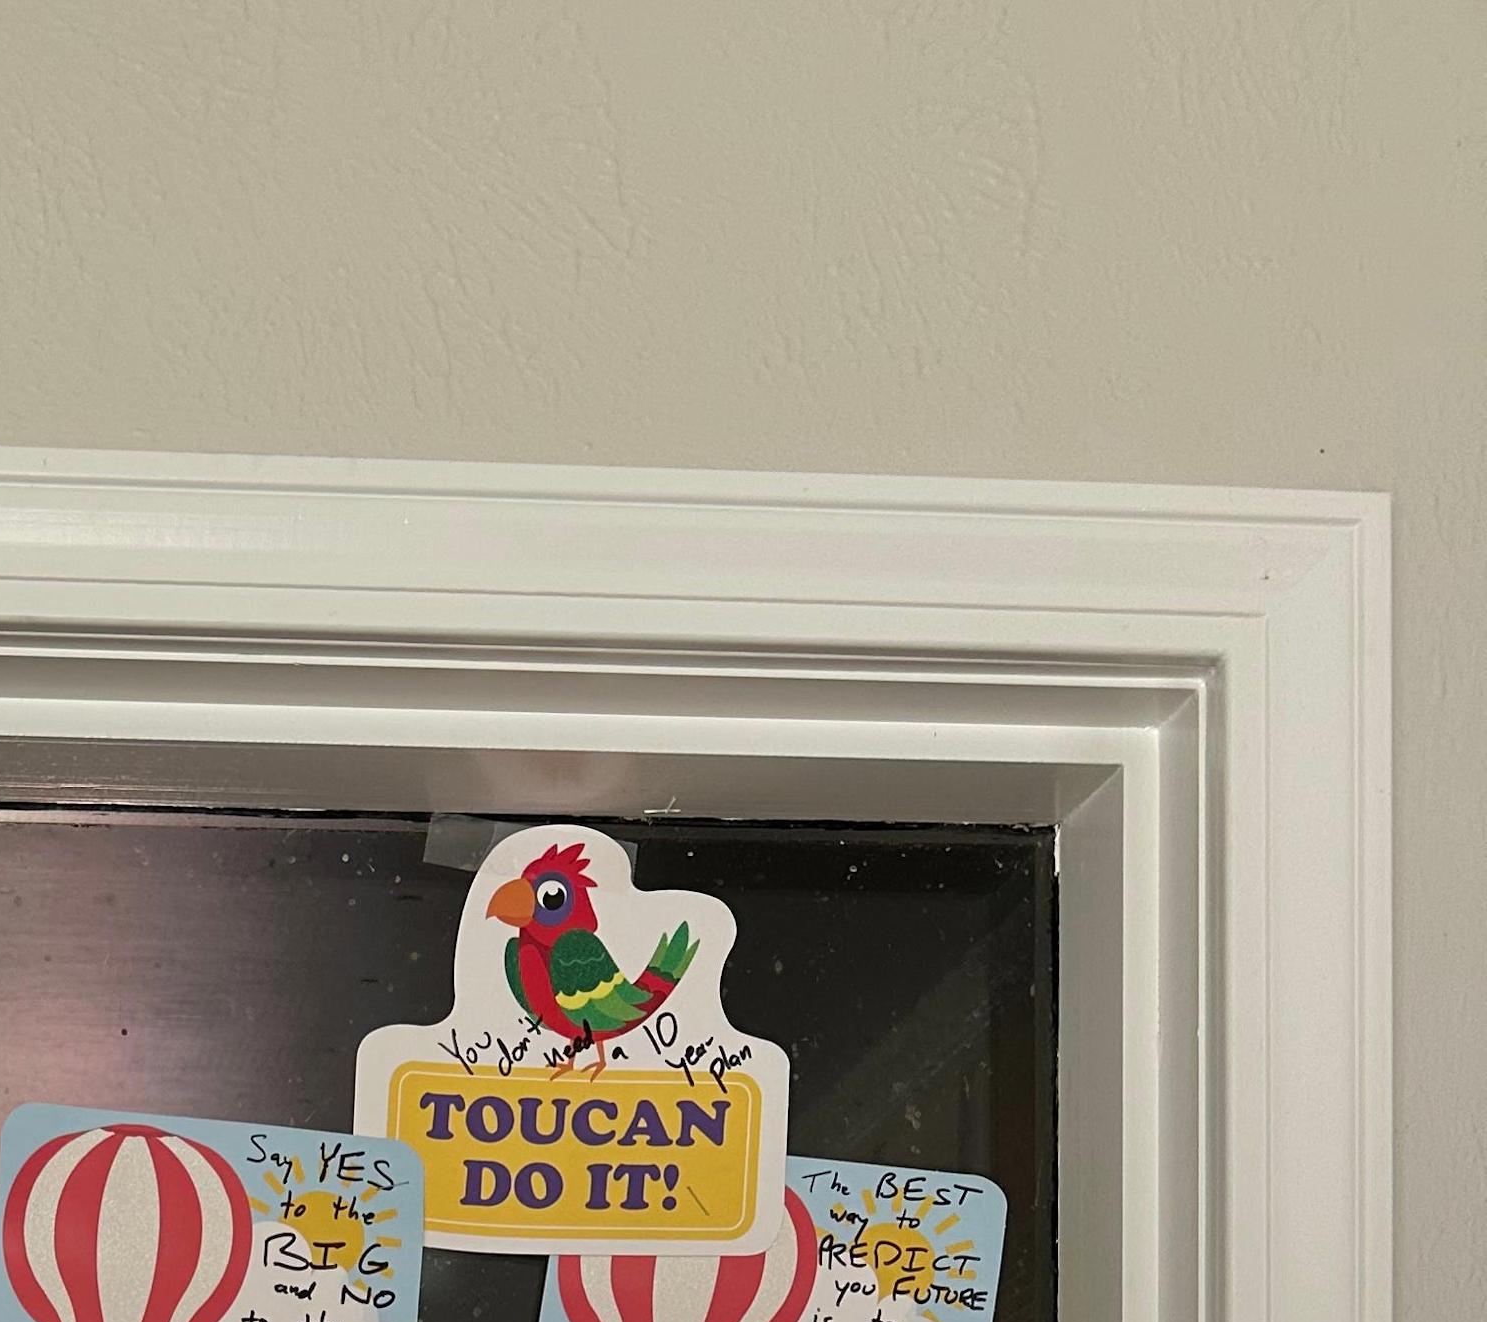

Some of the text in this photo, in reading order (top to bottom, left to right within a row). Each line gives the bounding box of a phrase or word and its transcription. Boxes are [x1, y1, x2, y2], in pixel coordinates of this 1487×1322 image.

[441, 1011, 753, 1095] You don't need a 10 plan
[419, 1091, 732, 1147] TOUCAN
[246, 1134, 397, 1191] Say YES
[459, 1158, 681, 1212] DO IT!
[801, 1170, 984, 1206] The BEST
[279, 1191, 377, 1226] to the
[829, 1208, 921, 1241] way to
[263, 1232, 390, 1275] BIG
[273, 1281, 396, 1309] and NO
[834, 1277, 989, 1312] you FUTURE
